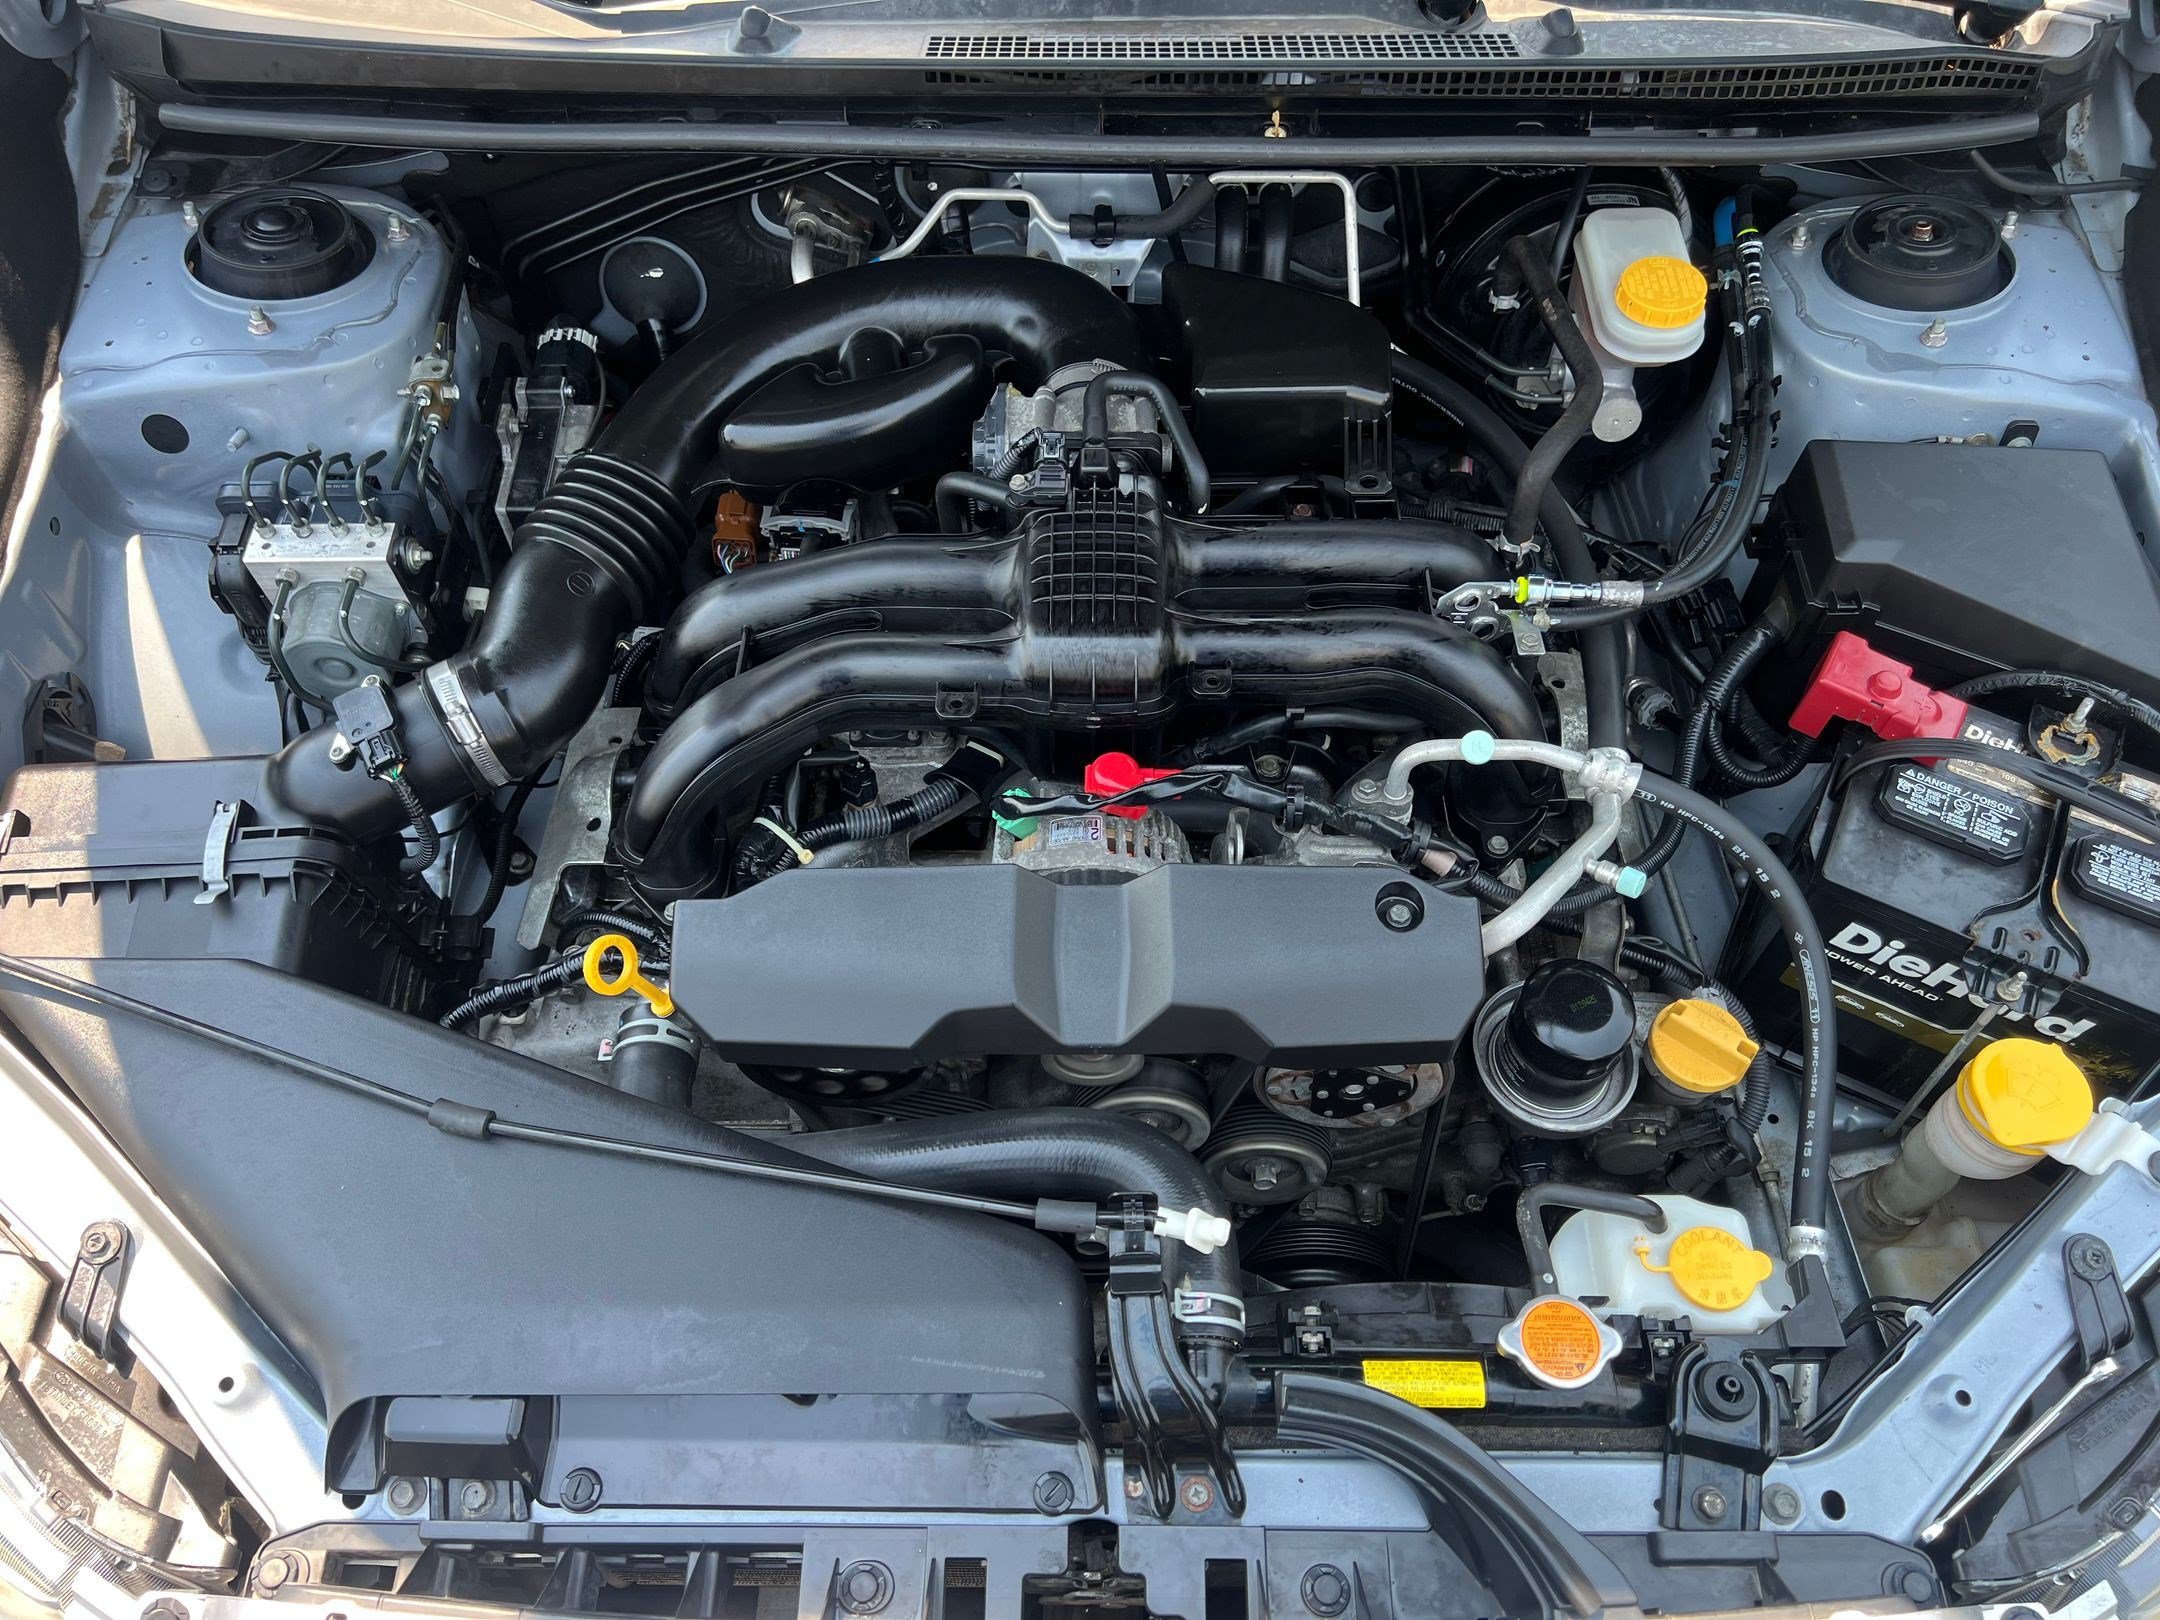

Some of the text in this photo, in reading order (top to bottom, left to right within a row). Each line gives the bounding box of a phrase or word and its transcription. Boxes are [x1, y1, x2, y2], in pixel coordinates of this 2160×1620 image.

[1916, 772, 1962, 795] DANGER
[1972, 793, 2014, 815] POISON
[1660, 800, 1674, 809] HP
[1731, 845, 1750, 861] BK
[1755, 867, 1770, 883] 15
[1770, 888, 1782, 899] 2
[1824, 949, 1940, 1002] OWER AHEAD
[1829, 922, 2097, 1043] DieHd
[1812, 1028, 1819, 1042] HP
[1810, 1046, 1819, 1098] HFC-134a
[1806, 1110, 1815, 1129] BK
[1803, 1140, 1812, 1157] 15
[1801, 1168, 1810, 1178] 2
[1675, 1230, 1744, 1257] COOLANT
